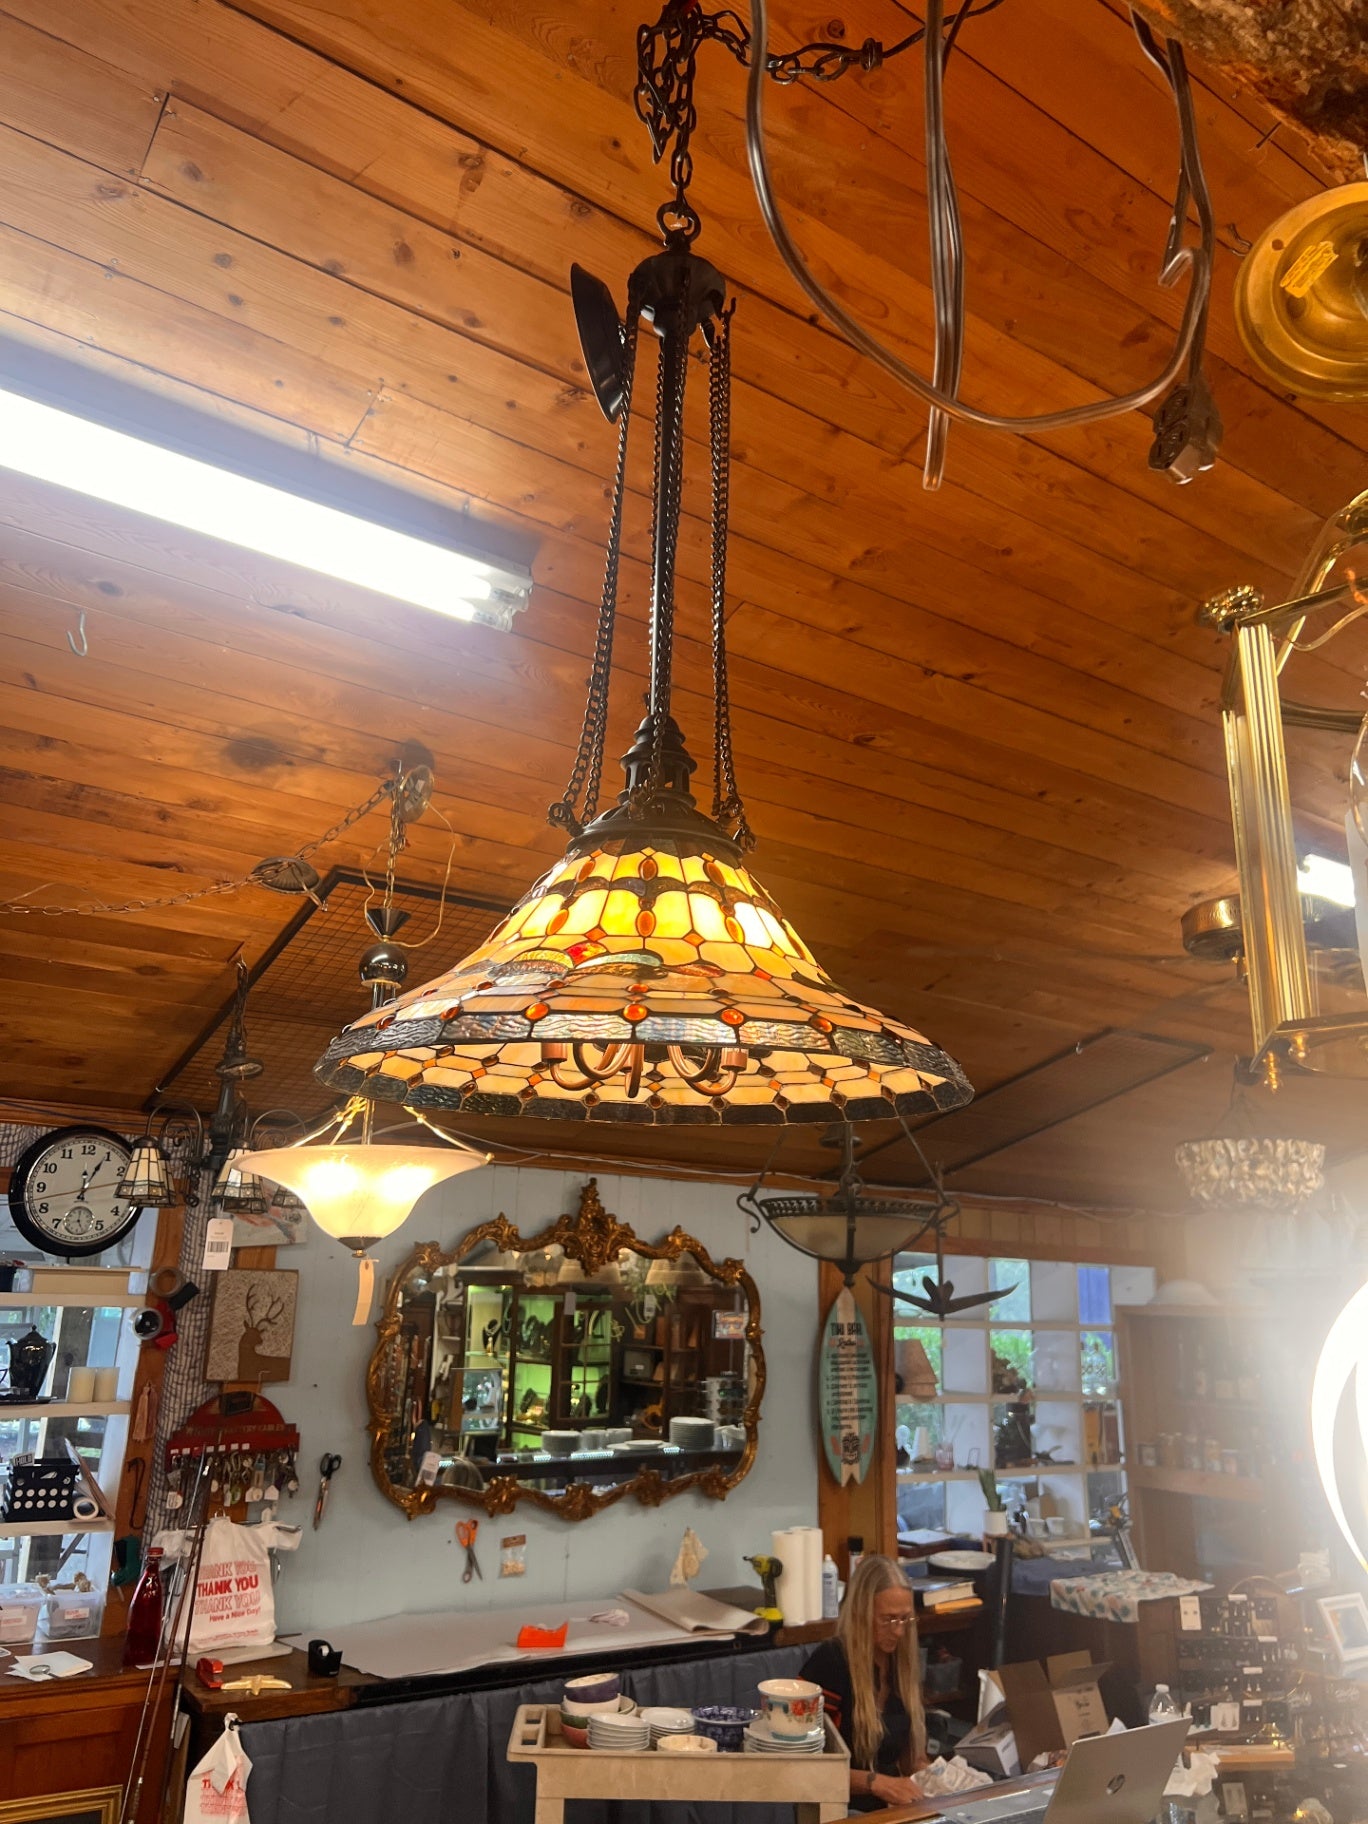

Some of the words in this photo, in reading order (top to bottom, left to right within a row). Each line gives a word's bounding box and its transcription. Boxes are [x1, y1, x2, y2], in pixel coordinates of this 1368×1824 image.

[60, 1149, 74, 1159] 11
[81, 1145, 96, 1156] 12
[104, 1152, 111, 1161] 1
[43, 1163, 58, 1174] 10
[116, 1166, 125, 1177] 2
[36, 1182, 46, 1193] 9
[38, 1202, 49, 1214] 8
[110, 1206, 120, 1216] 4
[52, 1218, 62, 1229] 7
[94, 1220, 104, 1231] 5
[197, 1579, 233, 1598] THANK
[235, 1574, 259, 1592] YOU
[194, 1595, 233, 1615] THANK
[234, 1591, 261, 1609] YOU
[209, 1614, 224, 1622] Have
[231, 1611, 245, 1619] Nice
